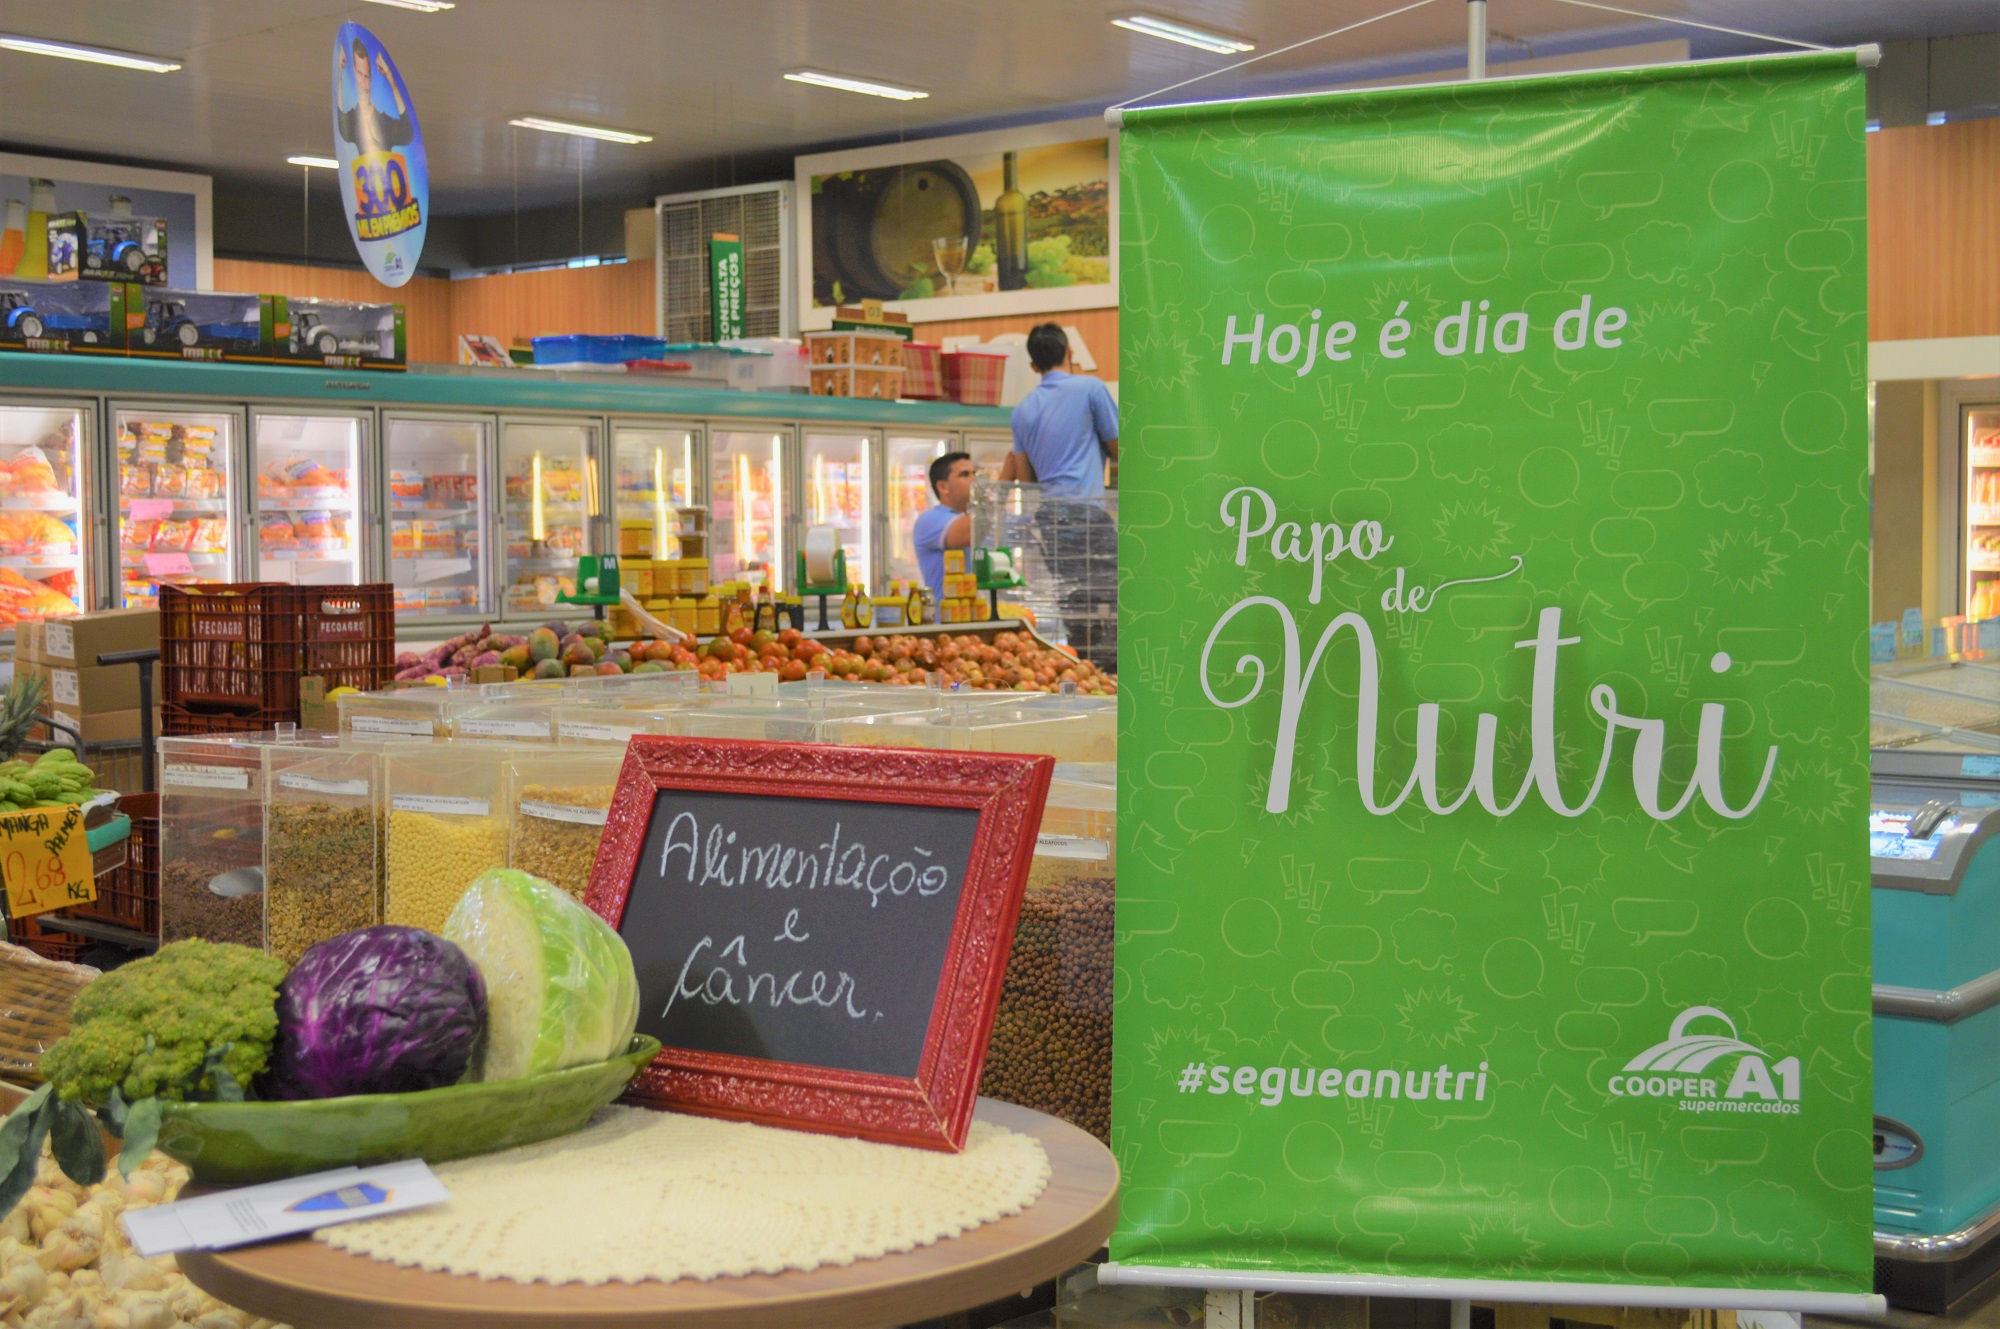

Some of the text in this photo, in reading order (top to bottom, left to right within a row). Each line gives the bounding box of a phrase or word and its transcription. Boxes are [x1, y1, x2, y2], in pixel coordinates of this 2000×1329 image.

[356, 159, 407, 214] 300
[728, 252, 741, 321] PREÇOS
[1221, 294, 1628, 377] Hoje é dia de
[603, 556, 617, 571] M
[1219, 486, 1395, 605] Papo
[199, 619, 244, 636] FECOAGRO
[320, 620, 364, 634] FECOAGRO
[1199, 595, 1778, 821] Nutri
[0, 813, 49, 841] MANGA
[44, 806, 80, 856] PALMER
[6, 850, 66, 908] 2,68
[66, 880, 90, 900] KG
[774, 908, 810, 942] e
[1177, 1061, 1489, 1107] #segueanutri
[1608, 1055, 1801, 1101] COOPER A1
[1678, 1099, 1800, 1115] supermercados
